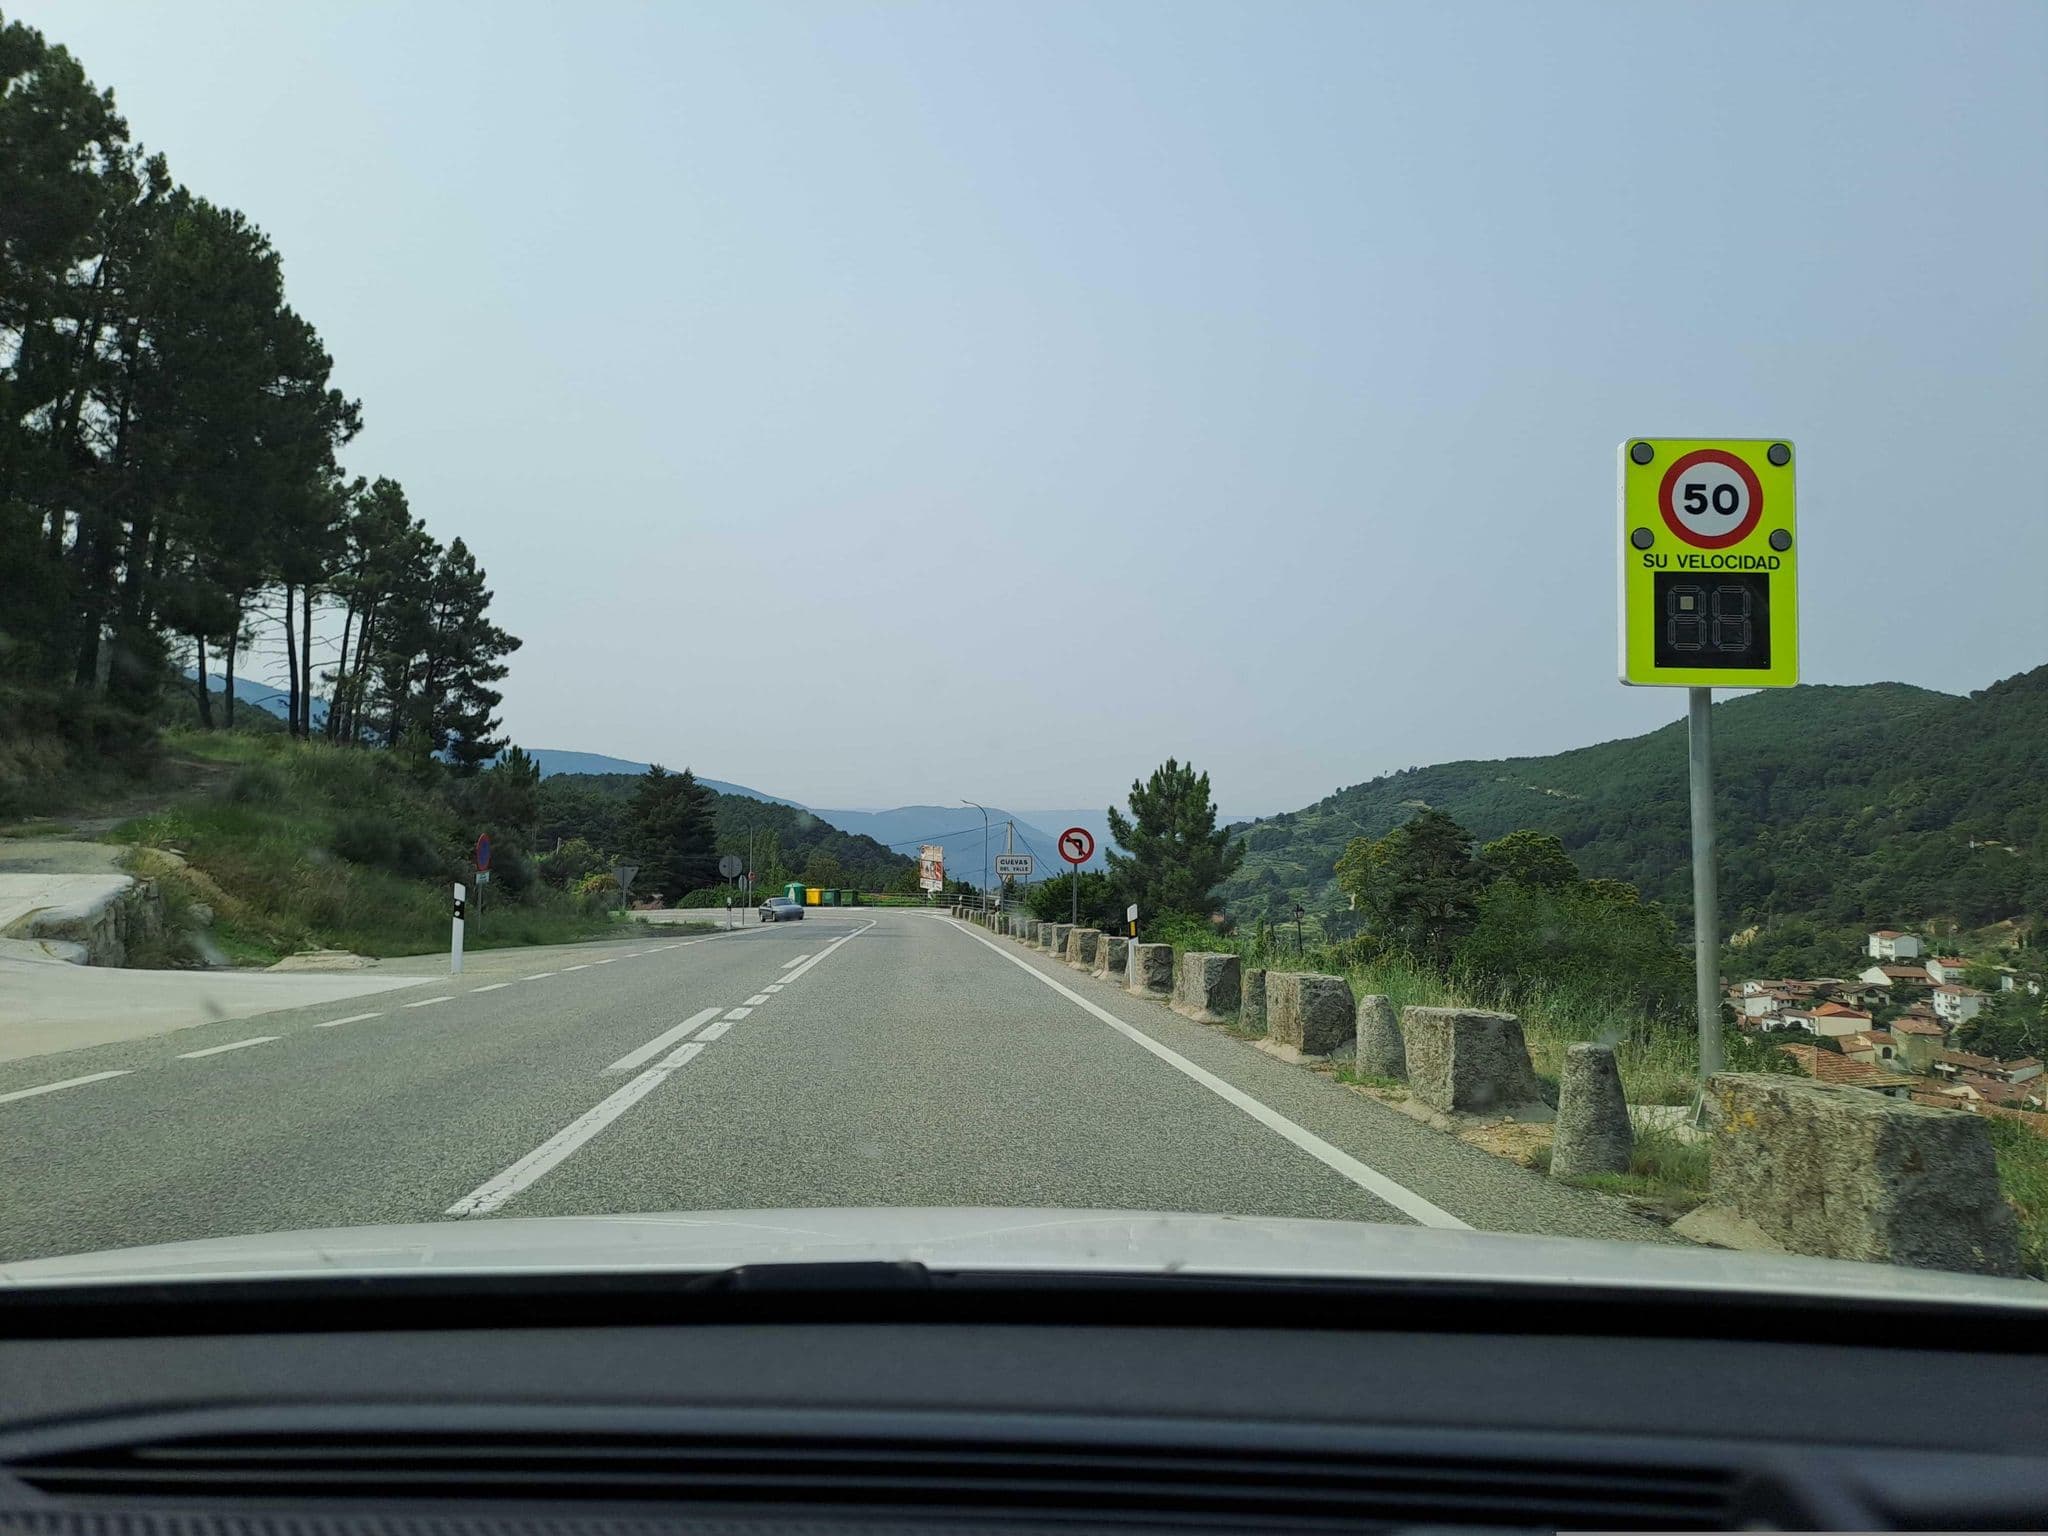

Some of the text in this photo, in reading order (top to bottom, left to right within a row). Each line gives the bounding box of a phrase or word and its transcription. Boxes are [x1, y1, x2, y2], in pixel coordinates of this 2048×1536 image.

[1683, 483, 1740, 516] 50
[1643, 553, 1781, 571] SU VELOCIDAD
